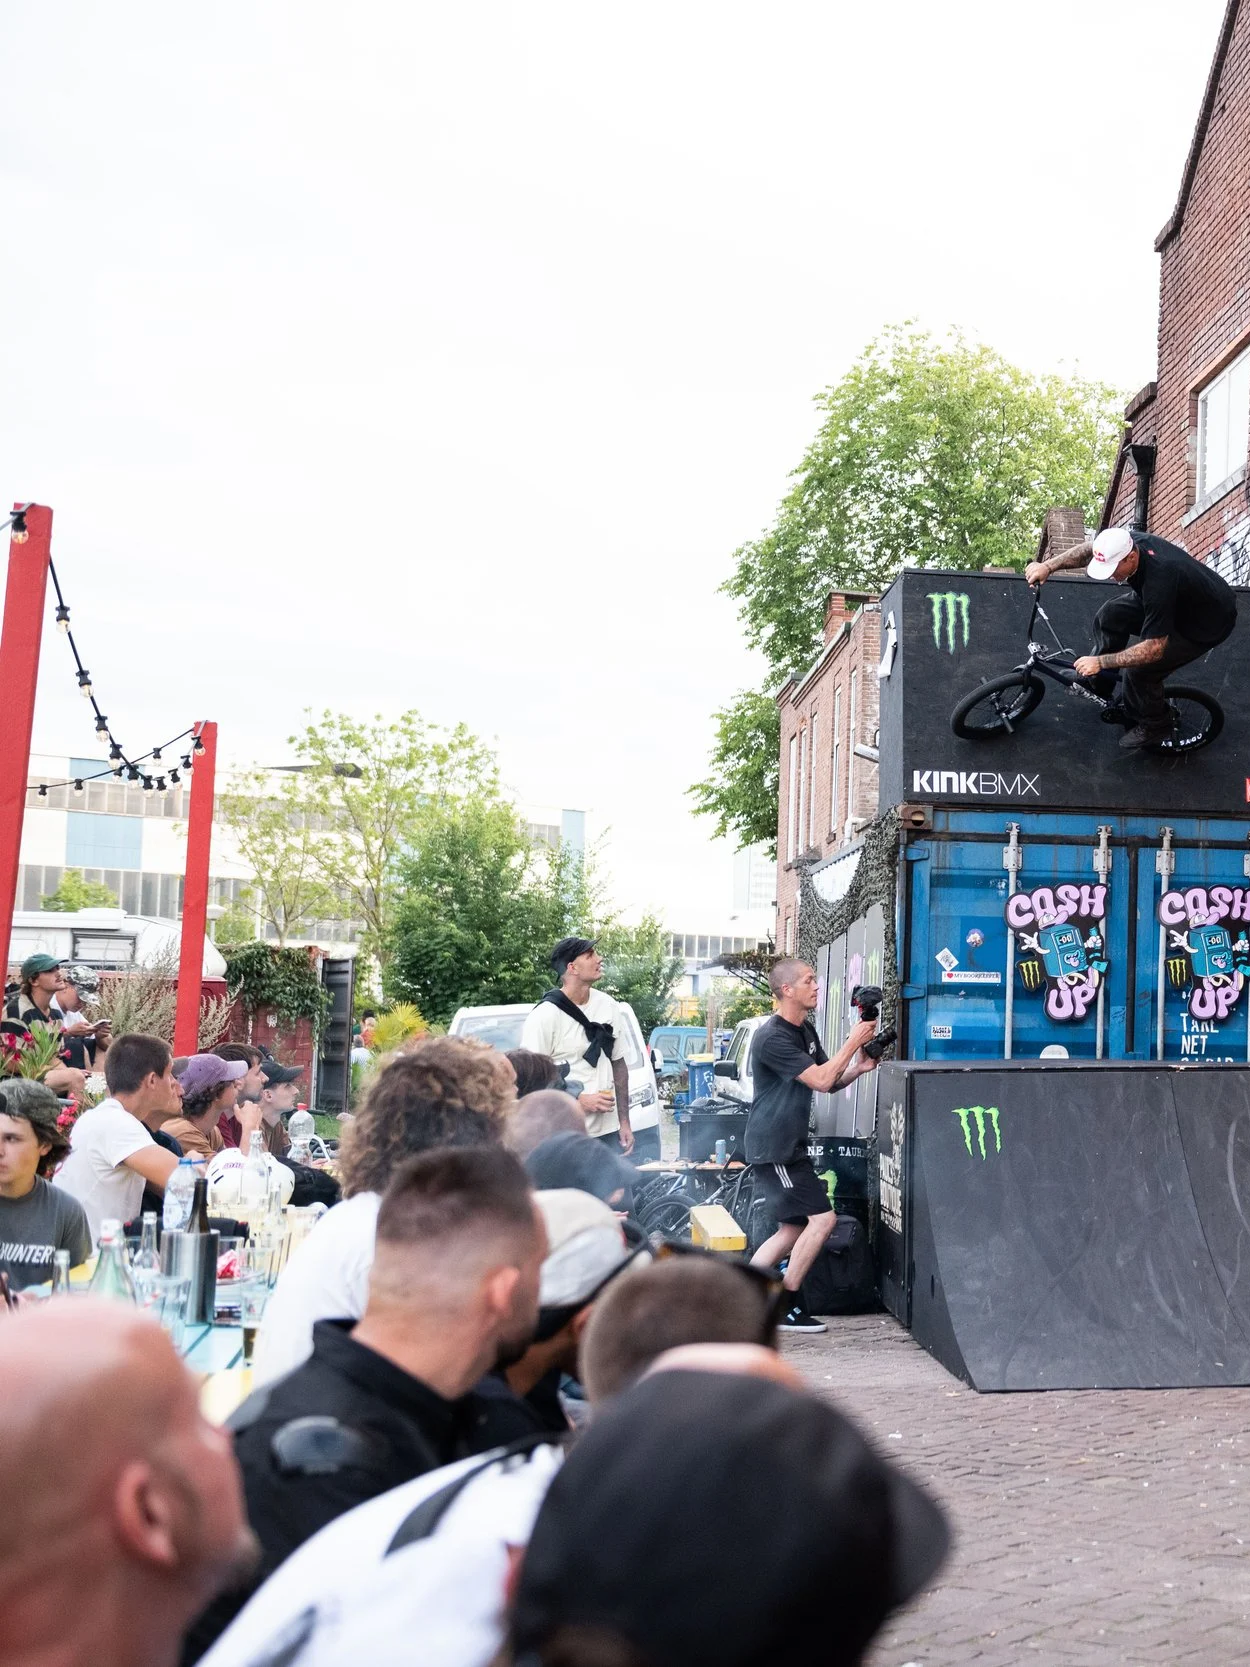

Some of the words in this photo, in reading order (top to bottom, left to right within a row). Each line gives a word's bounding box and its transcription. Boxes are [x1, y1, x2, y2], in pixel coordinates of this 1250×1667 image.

[1161, 733, 1203, 747] ODYSEY
[1007, 884, 1106, 920] CASH
[1046, 986, 1097, 1018] UP
[1190, 986, 1240, 1018] UP
[1181, 1035, 1208, 1055] NET
[0, 1242, 56, 1264] HUNTER
